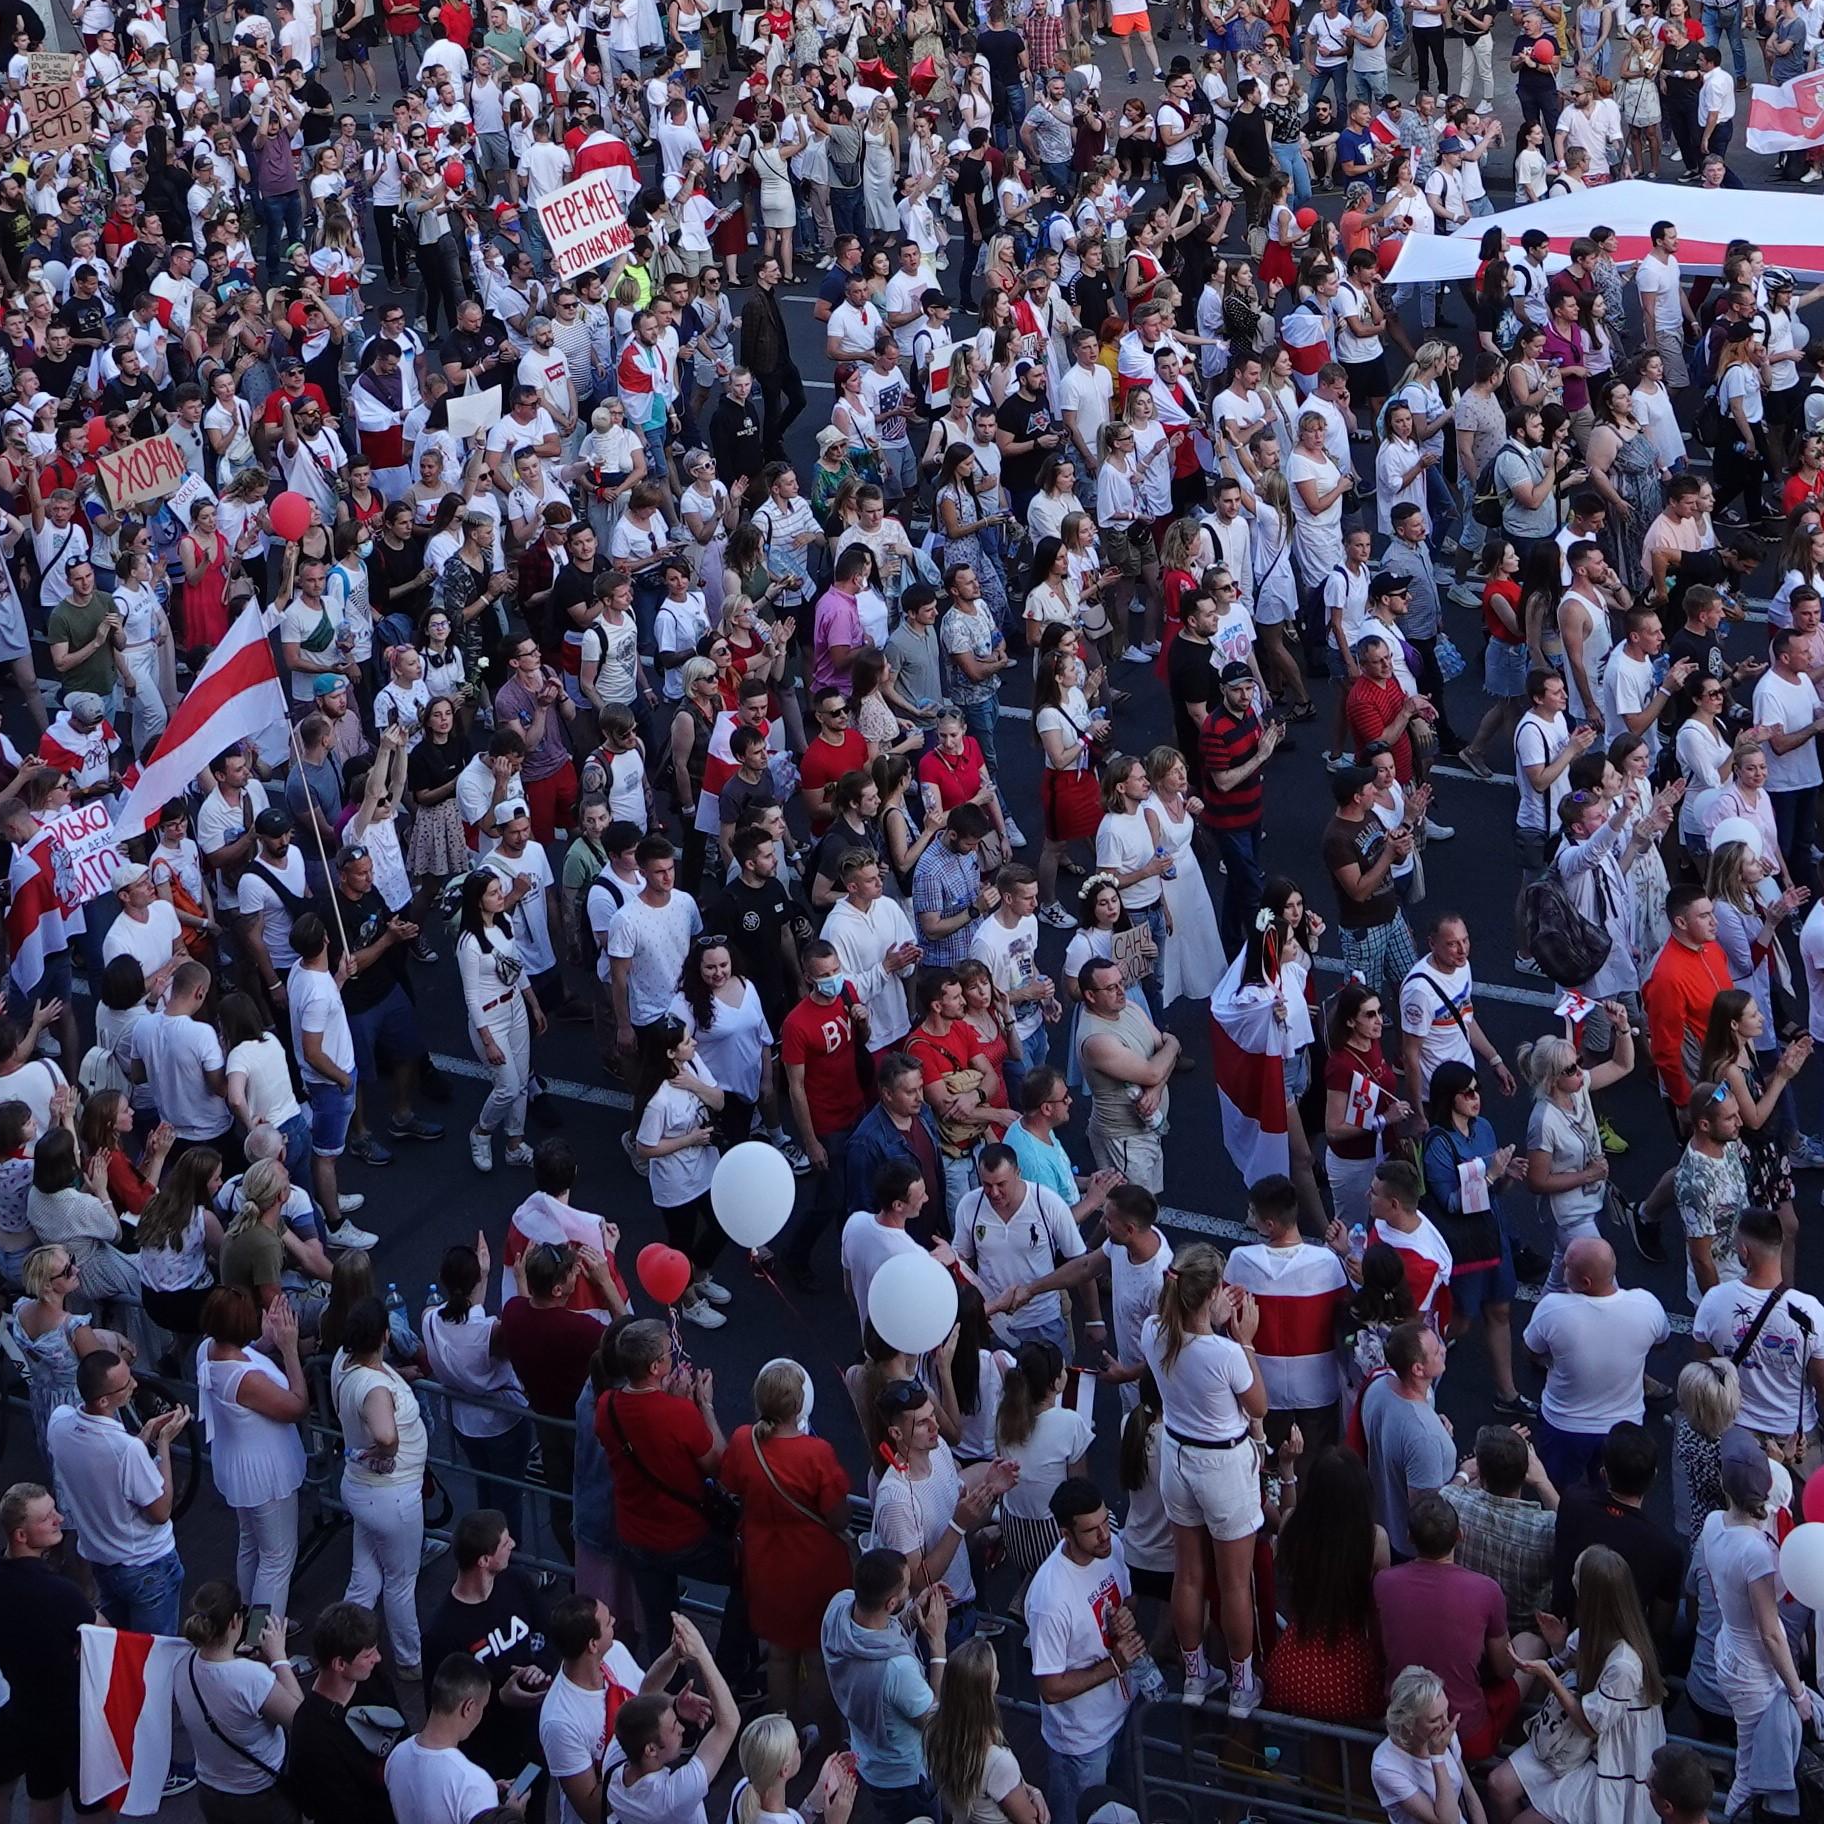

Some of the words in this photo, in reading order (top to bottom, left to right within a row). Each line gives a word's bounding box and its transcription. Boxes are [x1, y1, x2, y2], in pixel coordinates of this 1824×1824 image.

[33, 86, 70, 113] БОГ
[31, 112, 82, 143] ЕСТЬ
[542, 178, 624, 240] ПЕРЕМЕН
[97, 436, 185, 502] УХОДИ
[1113, 925, 1151, 960] САНЯ
[821, 1015, 852, 1055] BY
[470, 1615, 529, 1665] FILA
